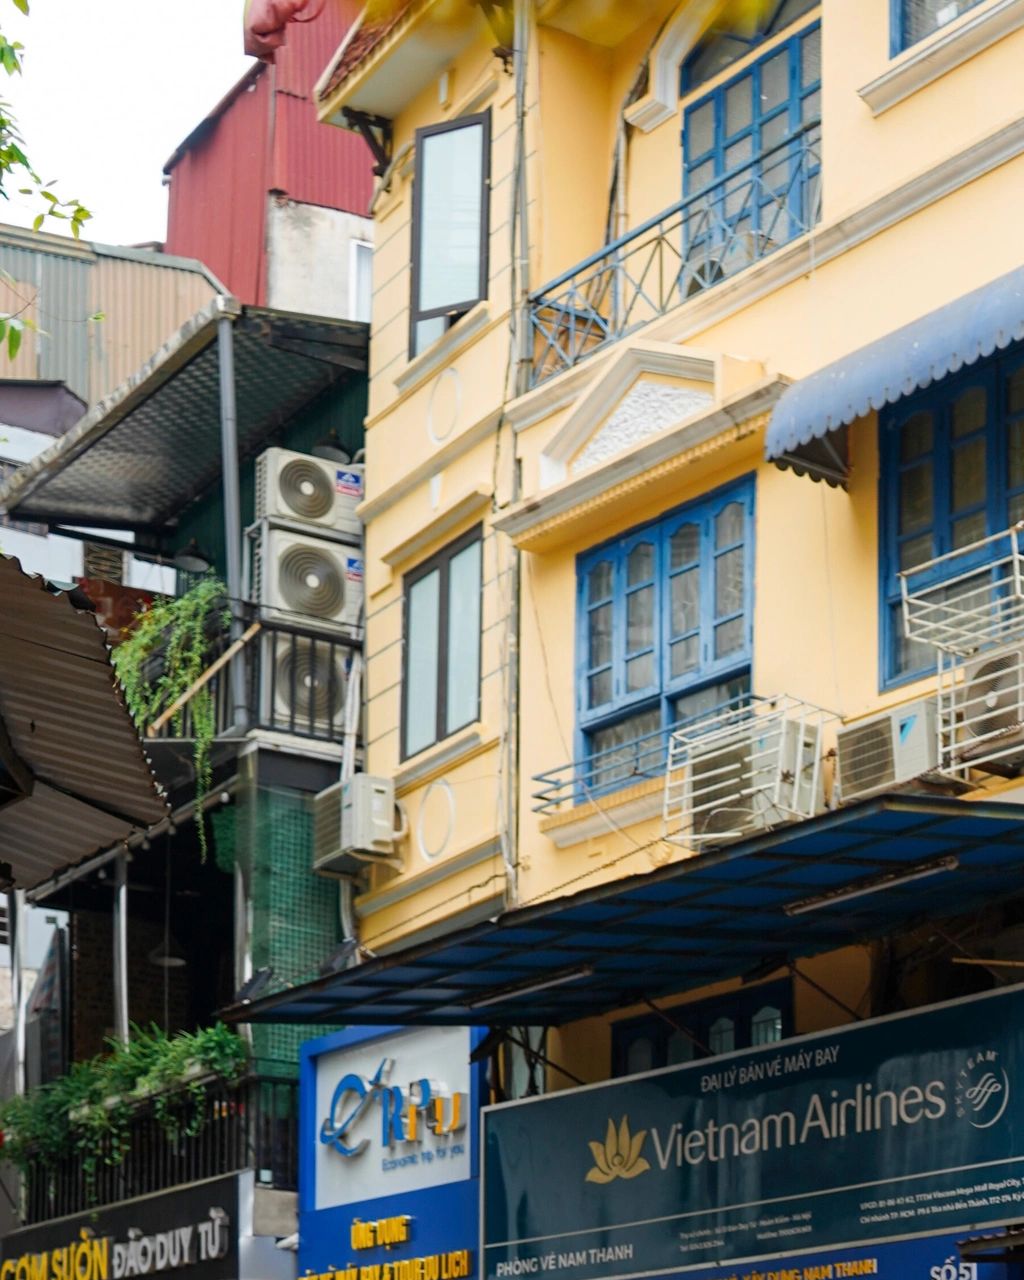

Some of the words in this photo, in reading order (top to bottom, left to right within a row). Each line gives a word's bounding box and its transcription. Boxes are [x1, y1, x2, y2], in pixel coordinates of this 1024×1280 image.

[738, 1060, 765, 1085] BÁN
[766, 1055, 782, 1078] VÉ
[783, 1049, 813, 1073] MÁY
[815, 1045, 840, 1067] BAY
[651, 1110, 796, 1171] Vietnam
[800, 1080, 947, 1143] Airlines
[112, 1228, 152, 1280] ĐÀO
[156, 1226, 194, 1270] DUY
[198, 1207, 227, 1260] TỪ
[496, 1254, 539, 1278] PHÒNG
[541, 1249, 557, 1271] VÉ
[558, 1248, 587, 1270] NAM
[588, 1244, 634, 1265] THANH
[834, 1258, 878, 1278] THANH
